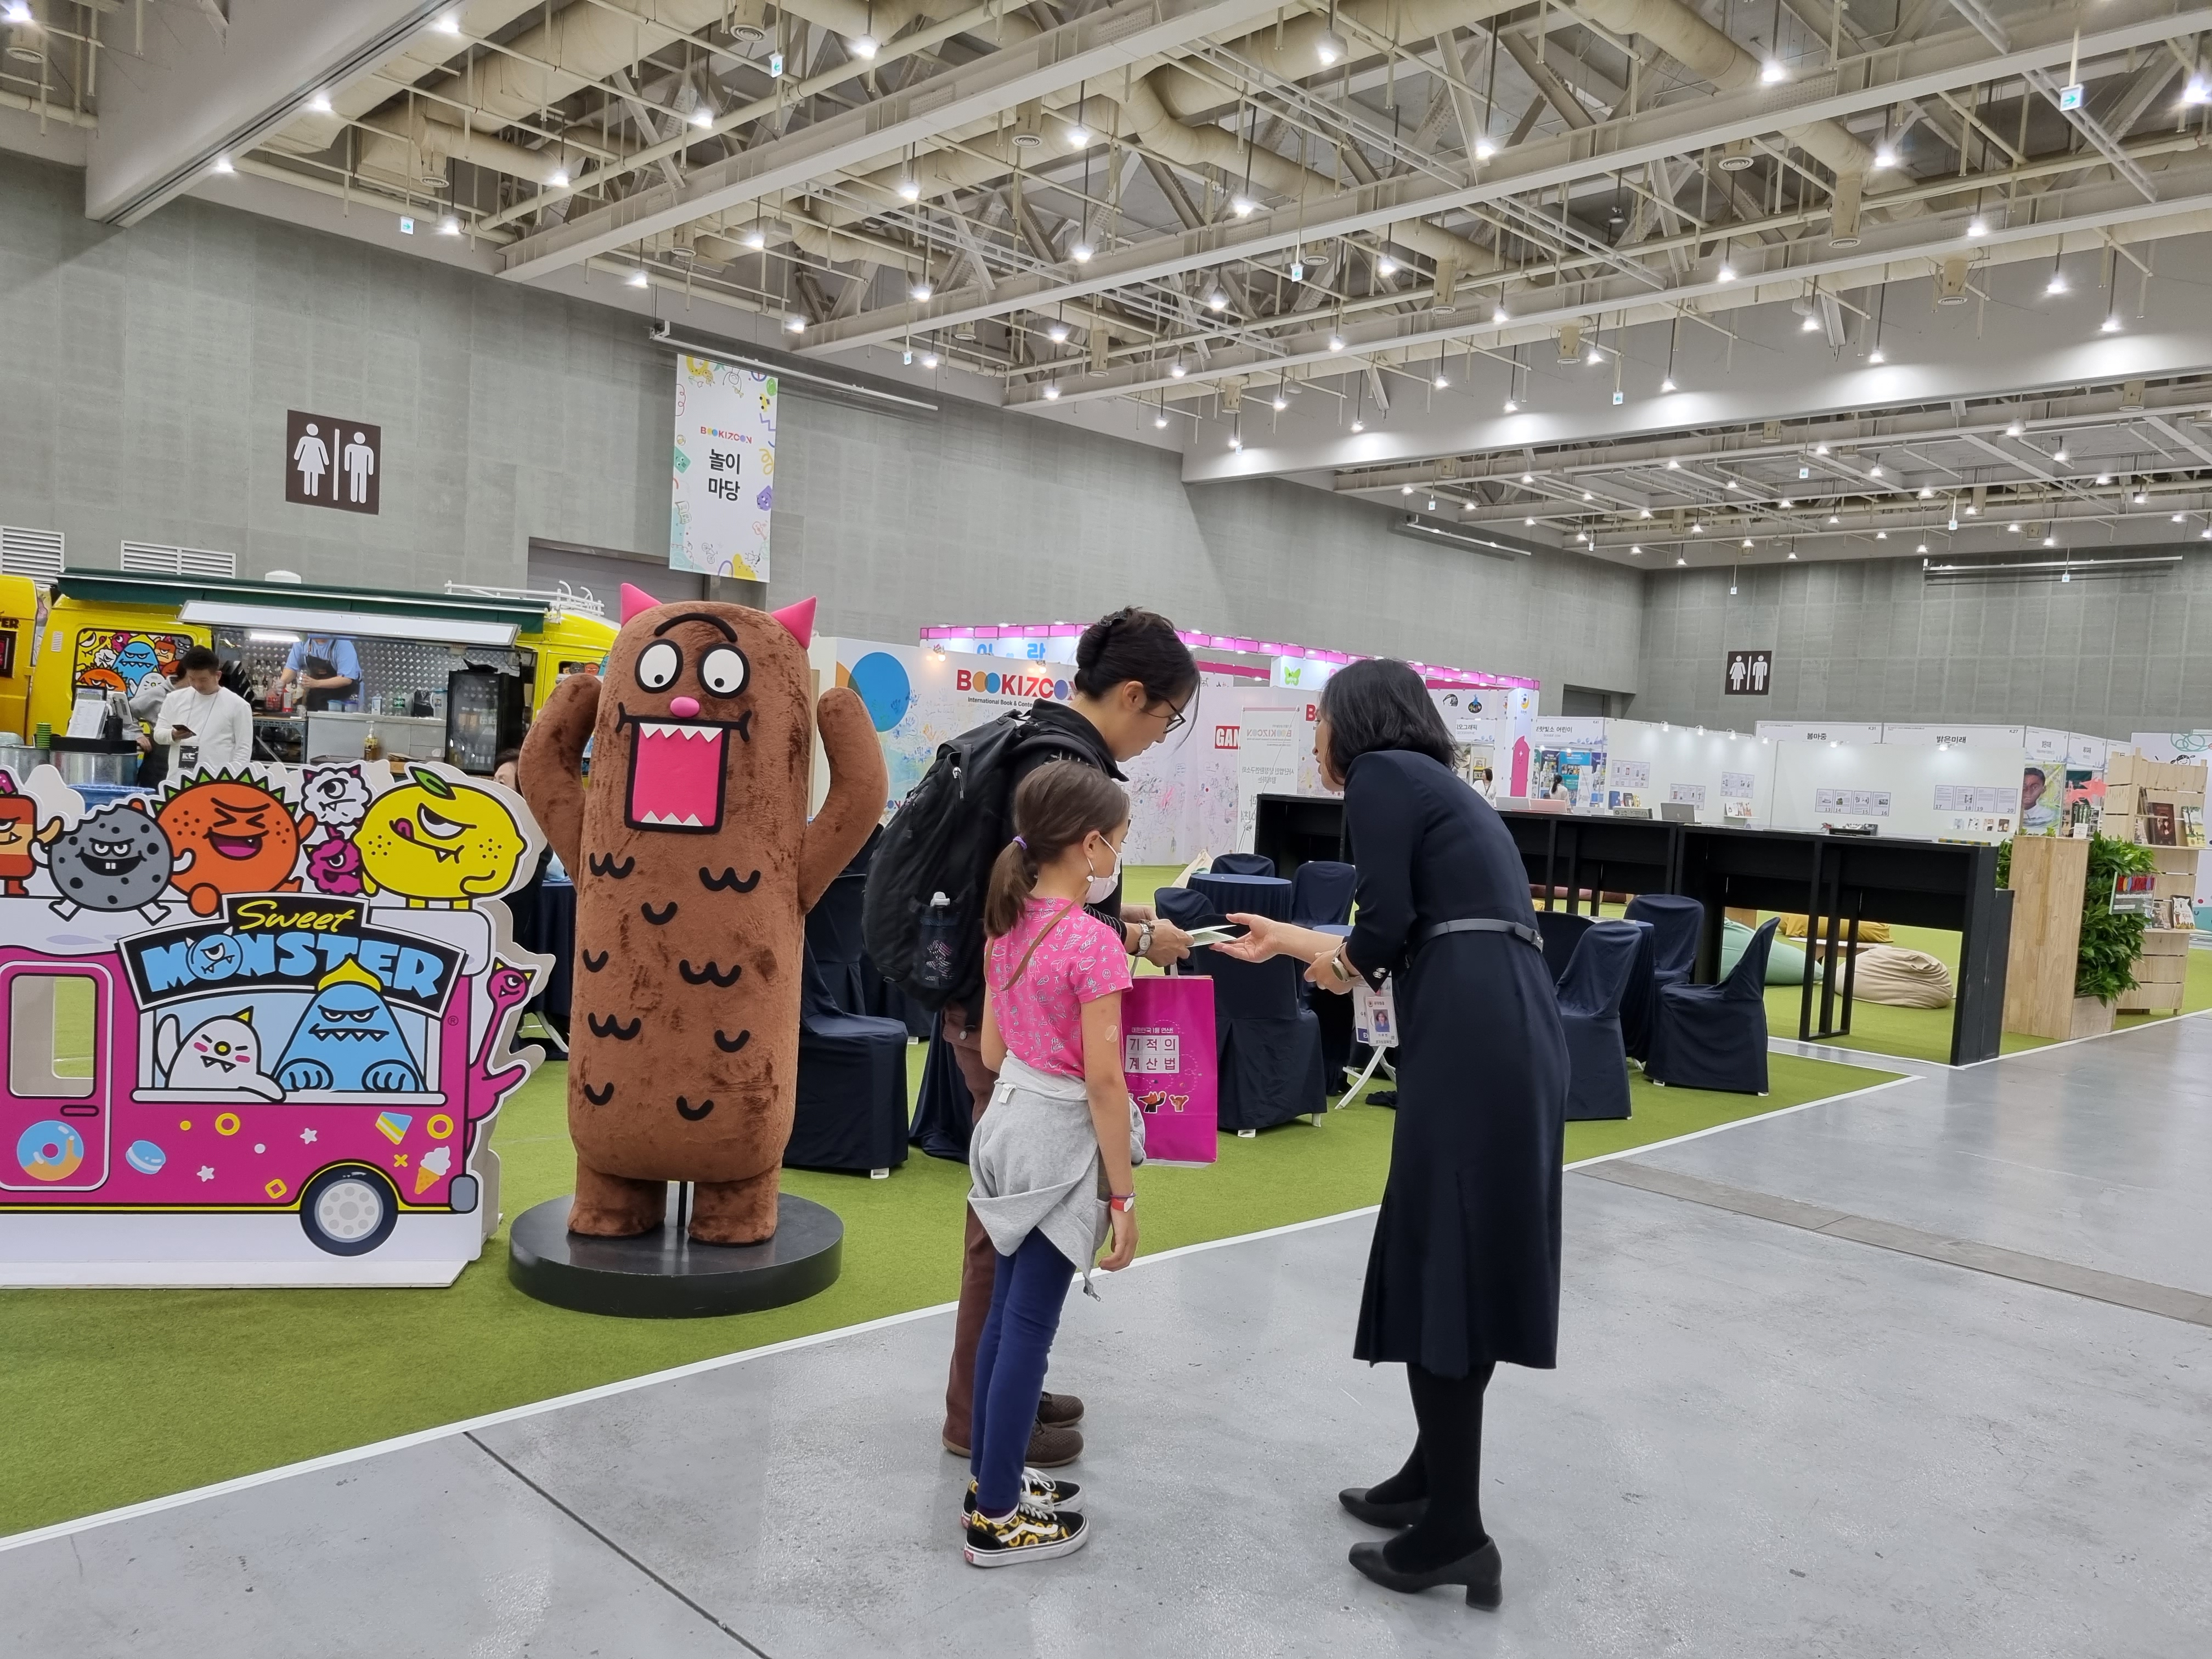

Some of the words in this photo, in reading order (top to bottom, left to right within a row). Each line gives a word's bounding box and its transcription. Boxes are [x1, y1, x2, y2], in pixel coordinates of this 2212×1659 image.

[701, 426, 752, 444] BOOKIZCON
[709, 449, 741, 475] 놀이
[708, 478, 741, 501] 마당
[968, 696, 1000, 705] International
[1936, 735, 1966, 744] 밝은미래
[236, 900, 357, 933] Sweet
[140, 927, 444, 998] MONSTER
[1130, 1038, 1175, 1051] 기적의
[1129, 1057, 1175, 1070] 계산법
